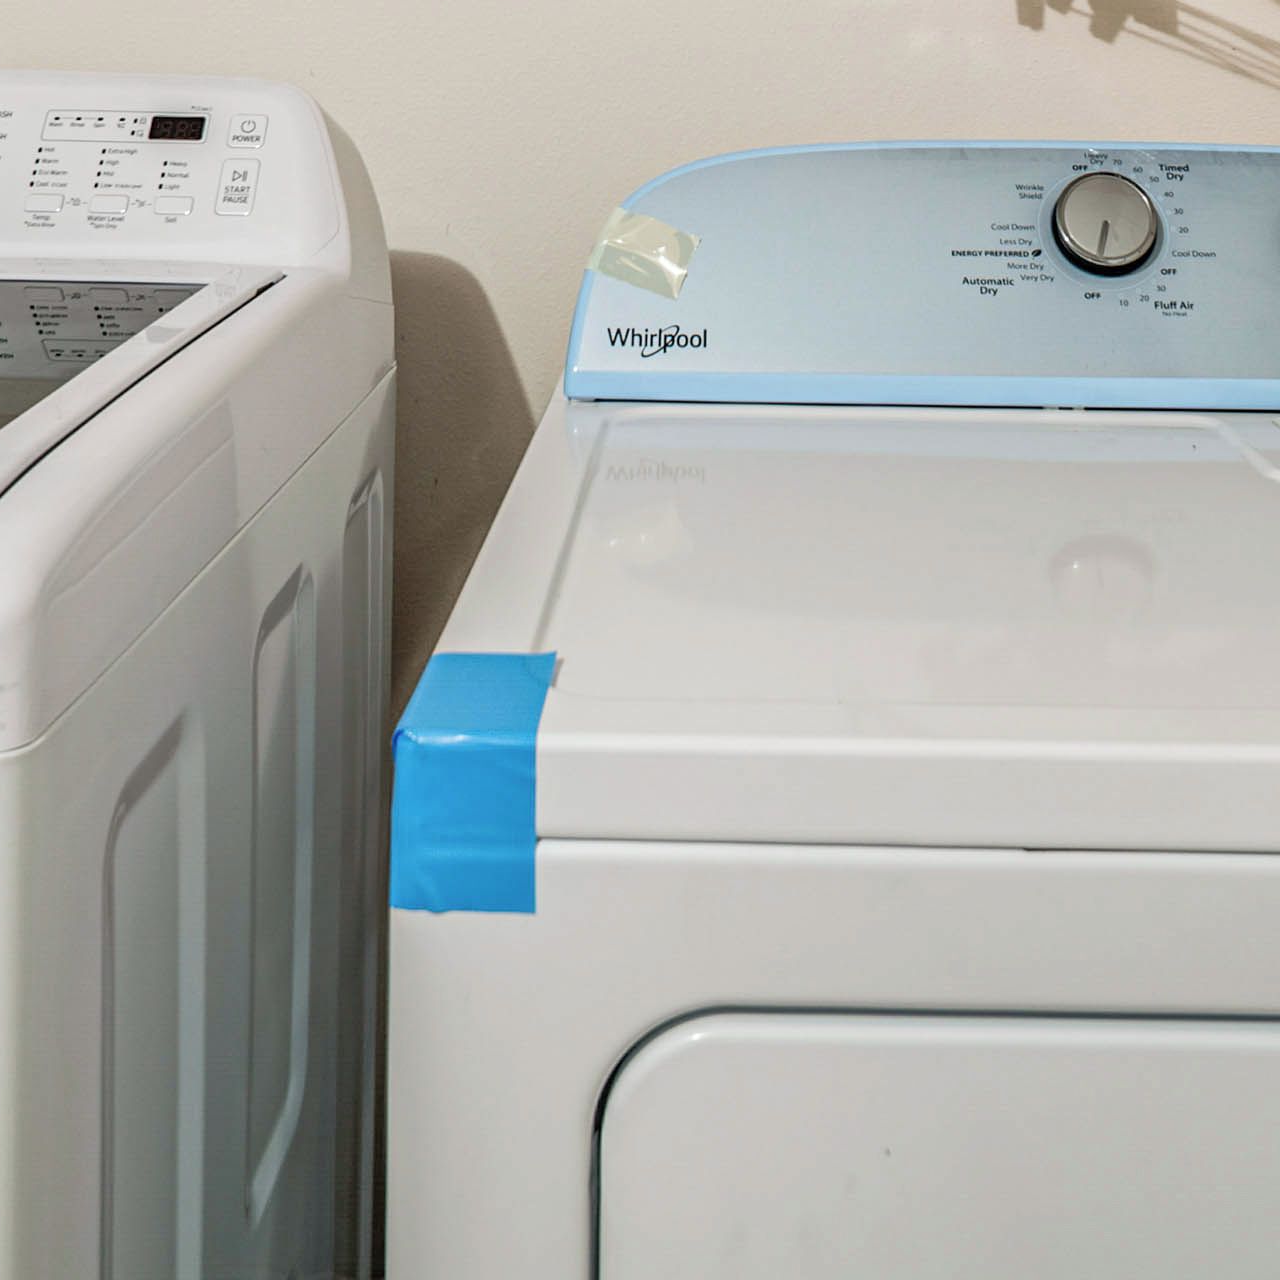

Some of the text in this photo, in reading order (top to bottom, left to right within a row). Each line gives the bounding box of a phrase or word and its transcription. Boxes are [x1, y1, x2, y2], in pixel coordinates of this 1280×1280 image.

[232, 134, 261, 142] POWER
[1158, 163, 1190, 172] Timed
[1166, 172, 1185, 182] Dry
[224, 185, 251, 194] START
[1015, 184, 1045, 192] Wrinkle
[222, 196, 248, 204] PAUSE
[990, 223, 1036, 231] Cool Down
[1017, 238, 1033, 247] Dry
[984, 250, 1030, 258] PREFERRED
[1171, 250, 1191, 258] Cool
[1007, 262, 1044, 271] More Dry
[1160, 268, 1177, 276] OFF
[962, 277, 1015, 286] Automatic
[1019, 274, 1055, 282] Very Dry
[979, 286, 999, 296] Dry
[1084, 292, 1101, 300] OFF
[1154, 301, 1195, 310] Fluff Air
[607, 325, 708, 357] Whirlpool
